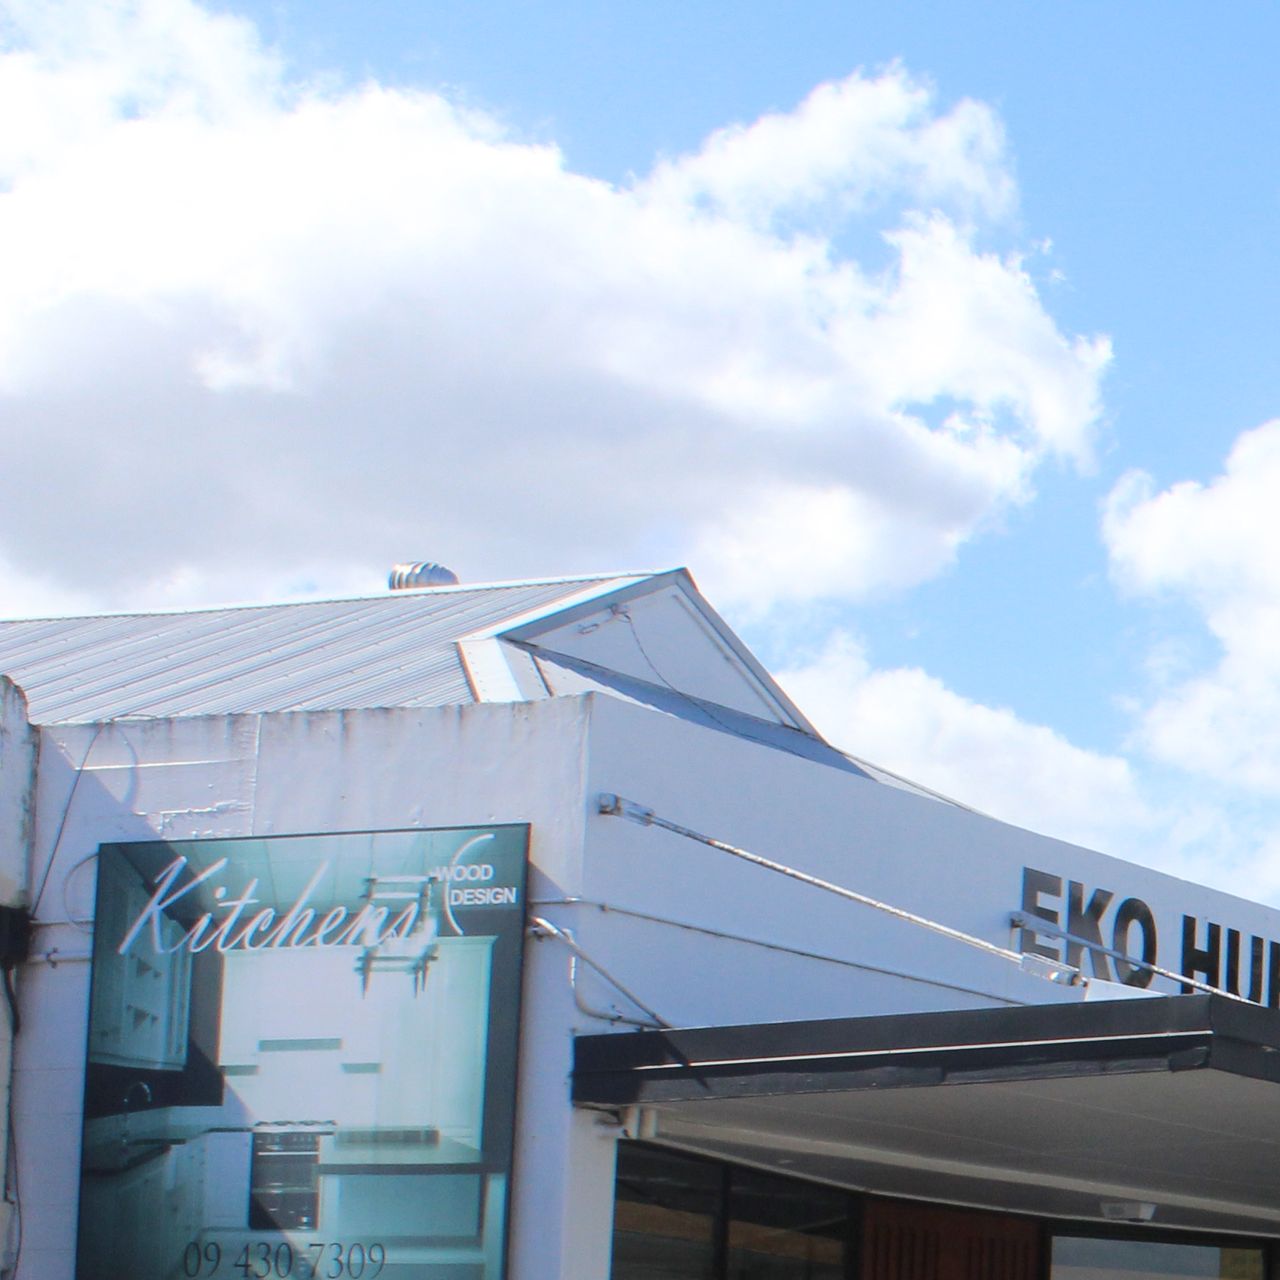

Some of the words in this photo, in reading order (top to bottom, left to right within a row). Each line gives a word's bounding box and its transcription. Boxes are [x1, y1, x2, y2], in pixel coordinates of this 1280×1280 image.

[434, 864, 493, 882] WOOD
[119, 856, 424, 956] Kitchens
[450, 887, 517, 905] DESIGN
[1020, 867, 1157, 990] EKO
[183, 1241, 222, 1279] 09
[234, 1242, 294, 1279] 430
[308, 1243, 386, 1280] 7309
